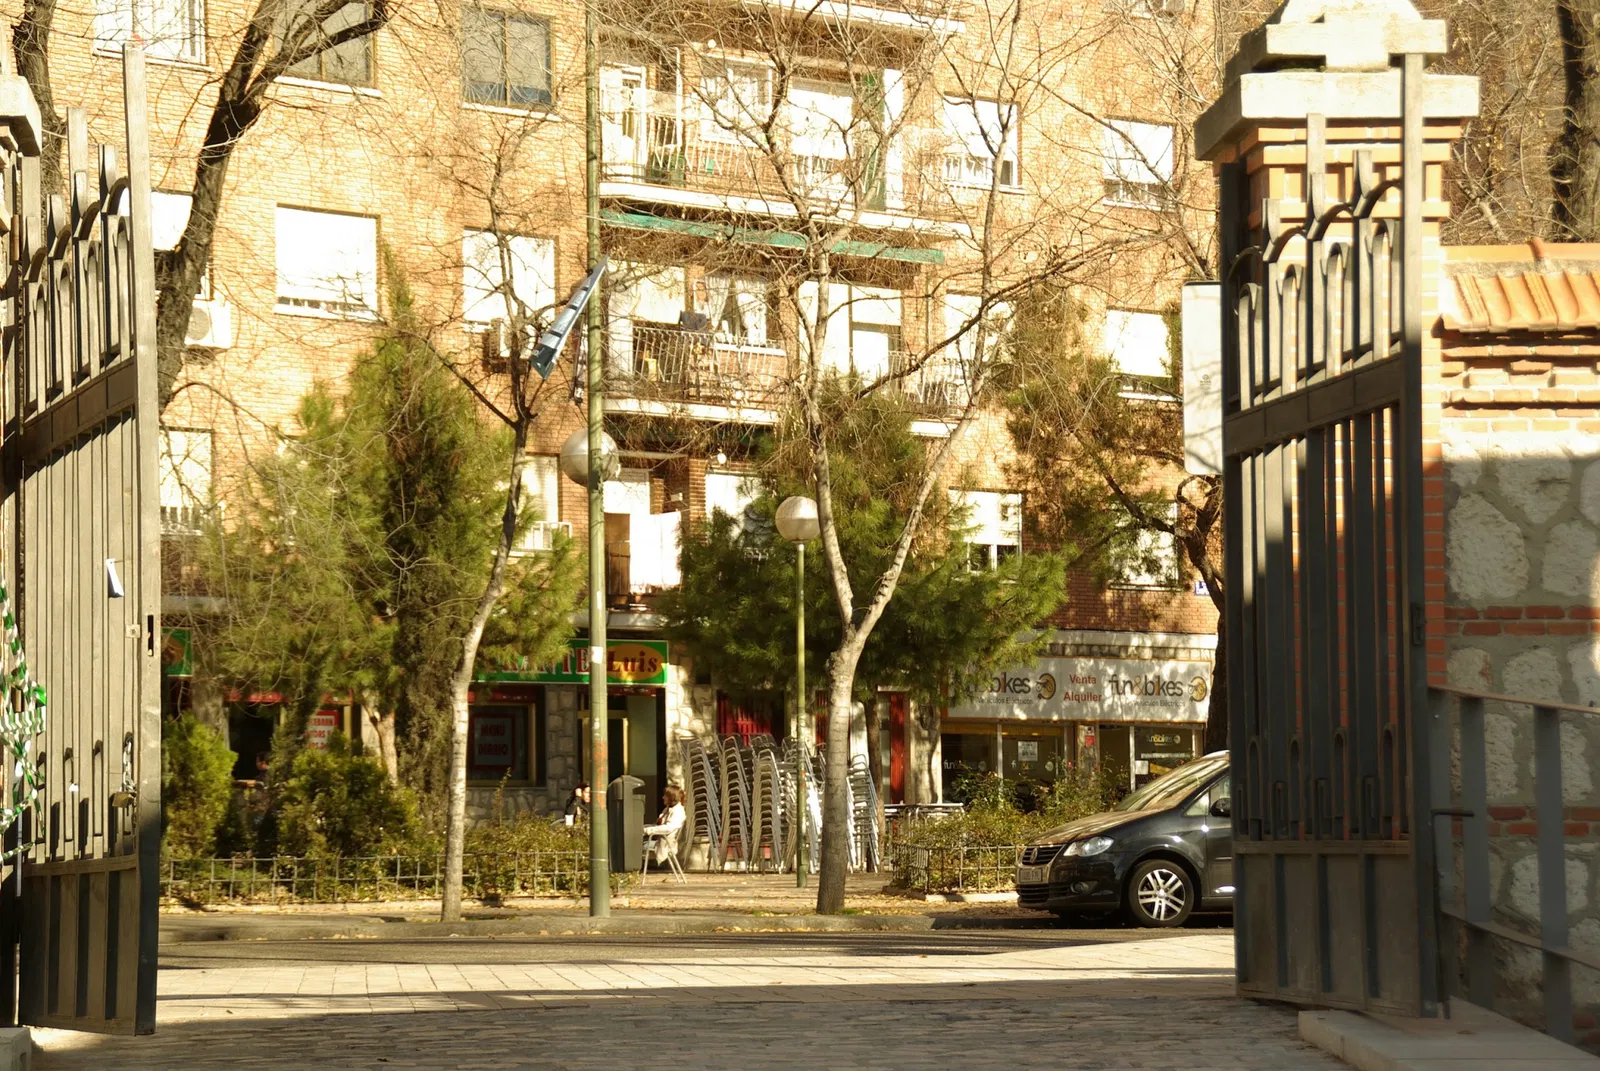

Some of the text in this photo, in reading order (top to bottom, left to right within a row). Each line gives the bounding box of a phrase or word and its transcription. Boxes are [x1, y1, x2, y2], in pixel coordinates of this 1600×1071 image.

[606, 651, 658, 673] Luis
[1069, 674, 1097, 685] Venta
[1108, 674, 1184, 696] fun&bikes
[1063, 691, 1102, 703] Alquiler
